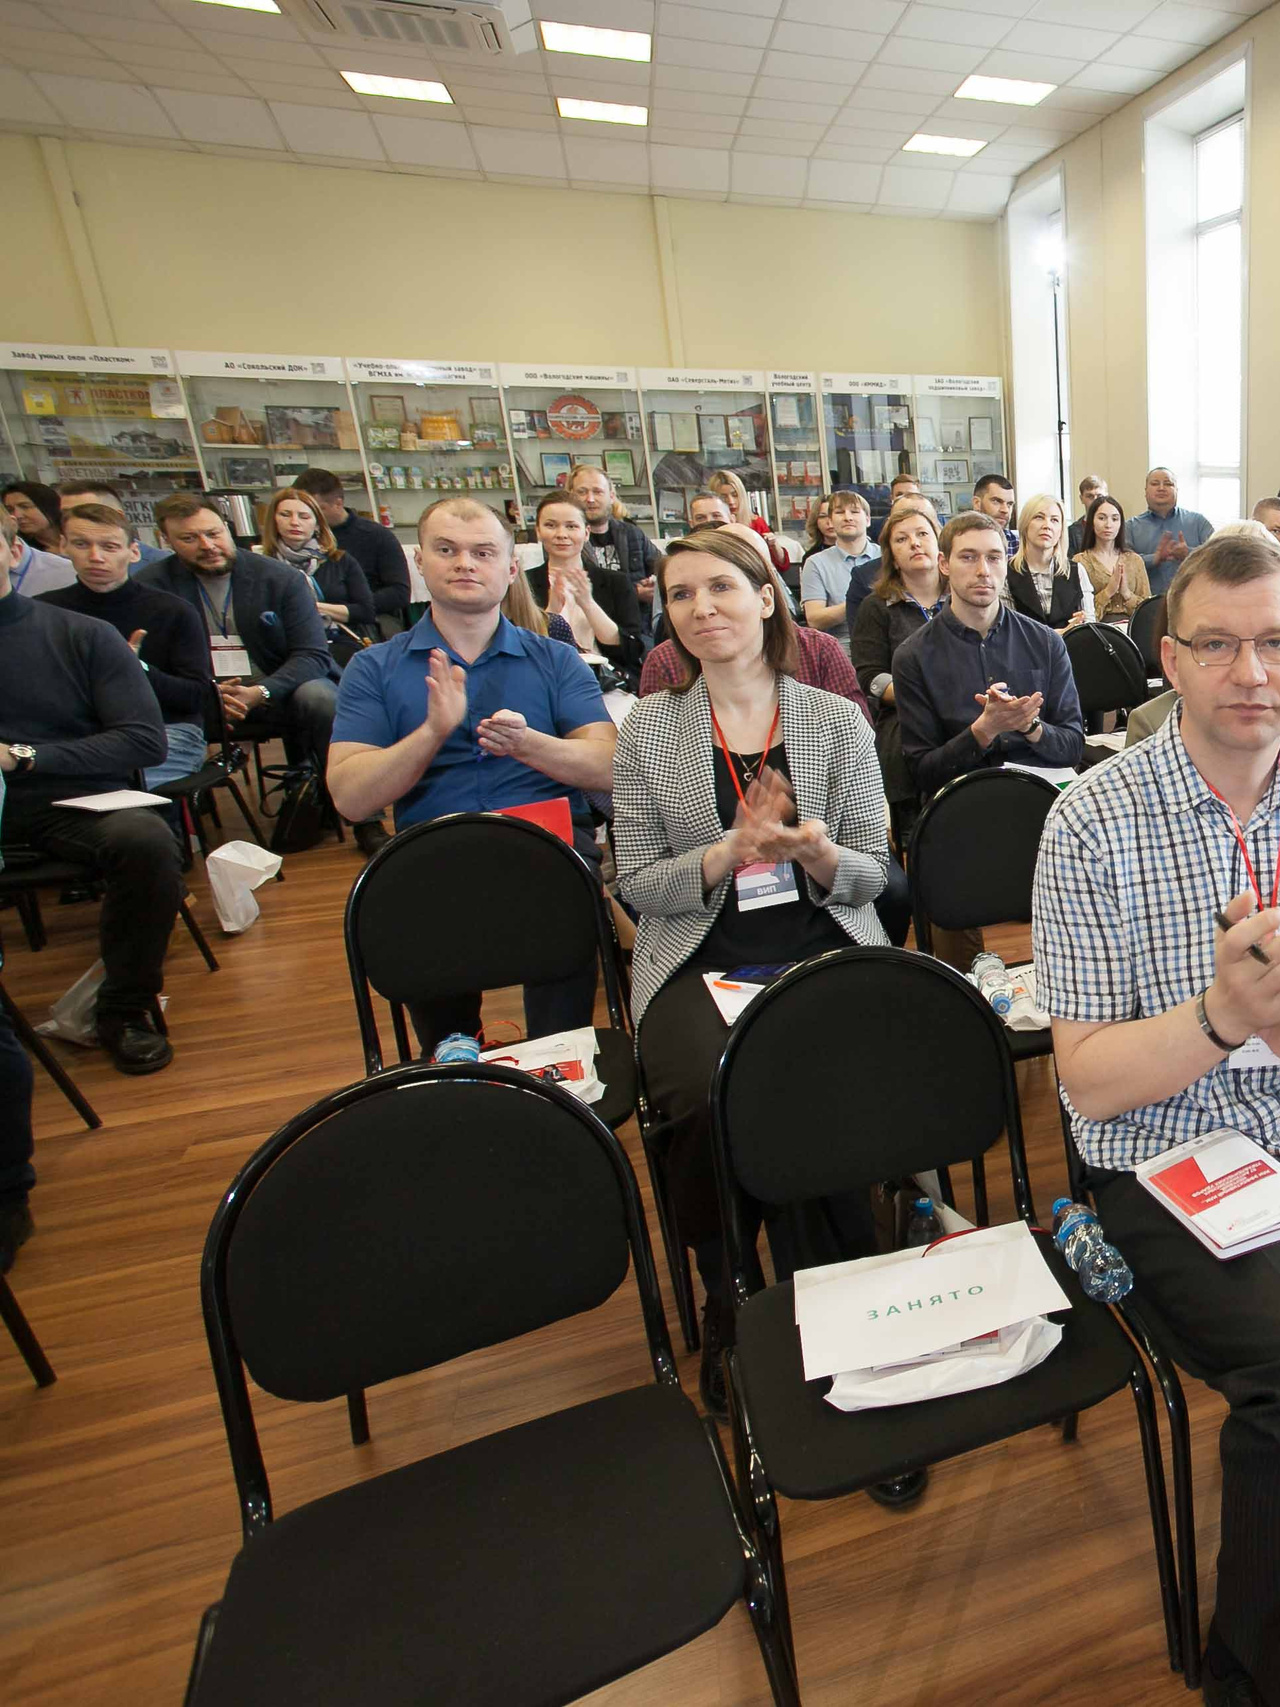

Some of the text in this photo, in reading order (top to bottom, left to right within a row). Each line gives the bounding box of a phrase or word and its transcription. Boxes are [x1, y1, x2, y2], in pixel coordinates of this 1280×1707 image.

[11, 351, 37, 360] Завод
[38, 353, 65, 361] умных
[67, 354, 86, 362] окон
[224, 362, 235, 370] АО
[238, 363, 286, 371] «Сокольский
[756, 885, 777, 896] ВИП
[866, 1285, 985, 1321] ЗАНЯТО
